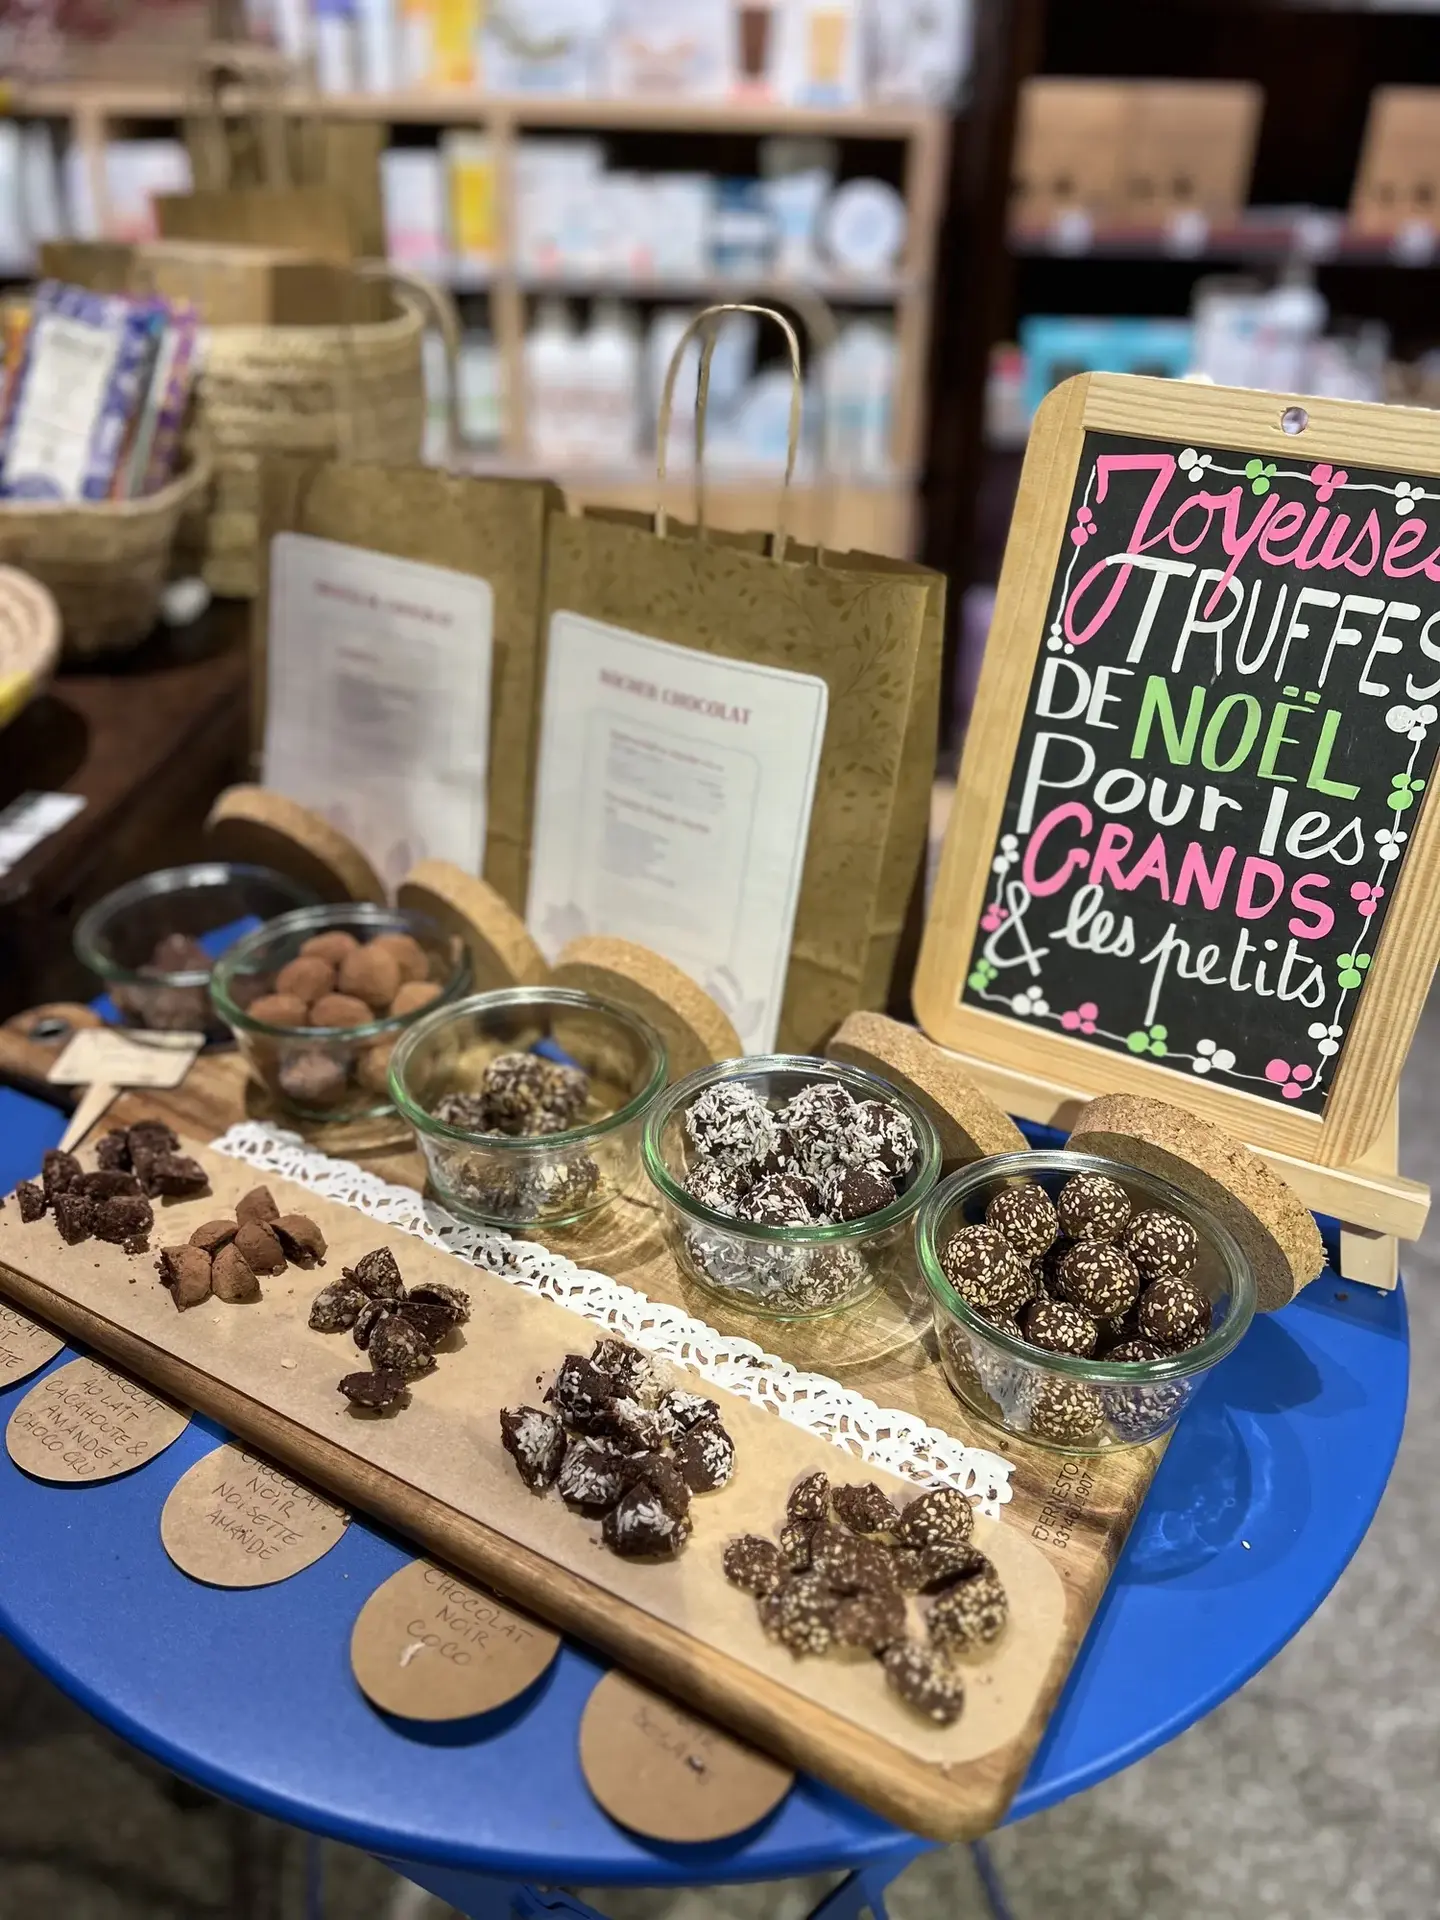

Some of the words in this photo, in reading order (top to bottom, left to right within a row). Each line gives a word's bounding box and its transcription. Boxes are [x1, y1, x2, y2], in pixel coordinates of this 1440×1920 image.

[1105, 553, 1440, 700] TRUFFES
[1035, 657, 1134, 729] DE
[1131, 675, 1360, 800] NOËL
[1017, 732, 1242, 833] Pour
[1258, 787, 1365, 866] les
[1022, 801, 1335, 939] GRANDS
[983, 880, 1050, 976] &
[1049, 883, 1136, 957] les
[1139, 923, 1326, 1026] petits
[14, 1411, 65, 1452] CHOCO
[63, 1451, 96, 1475] CRU
[44, 1405, 113, 1459] AMANDE
[45, 1380, 131, 1446] CACAHOUTE
[125, 1441, 149, 1458] &
[211, 1481, 304, 1546] NOISETTE
[245, 1476, 296, 1519] NOIR
[205, 1509, 280, 1560] AMANDE
[423, 1567, 534, 1644] CHOCOLAT
[435, 1604, 490, 1649] NOIR
[406, 1619, 472, 1666] COCO
